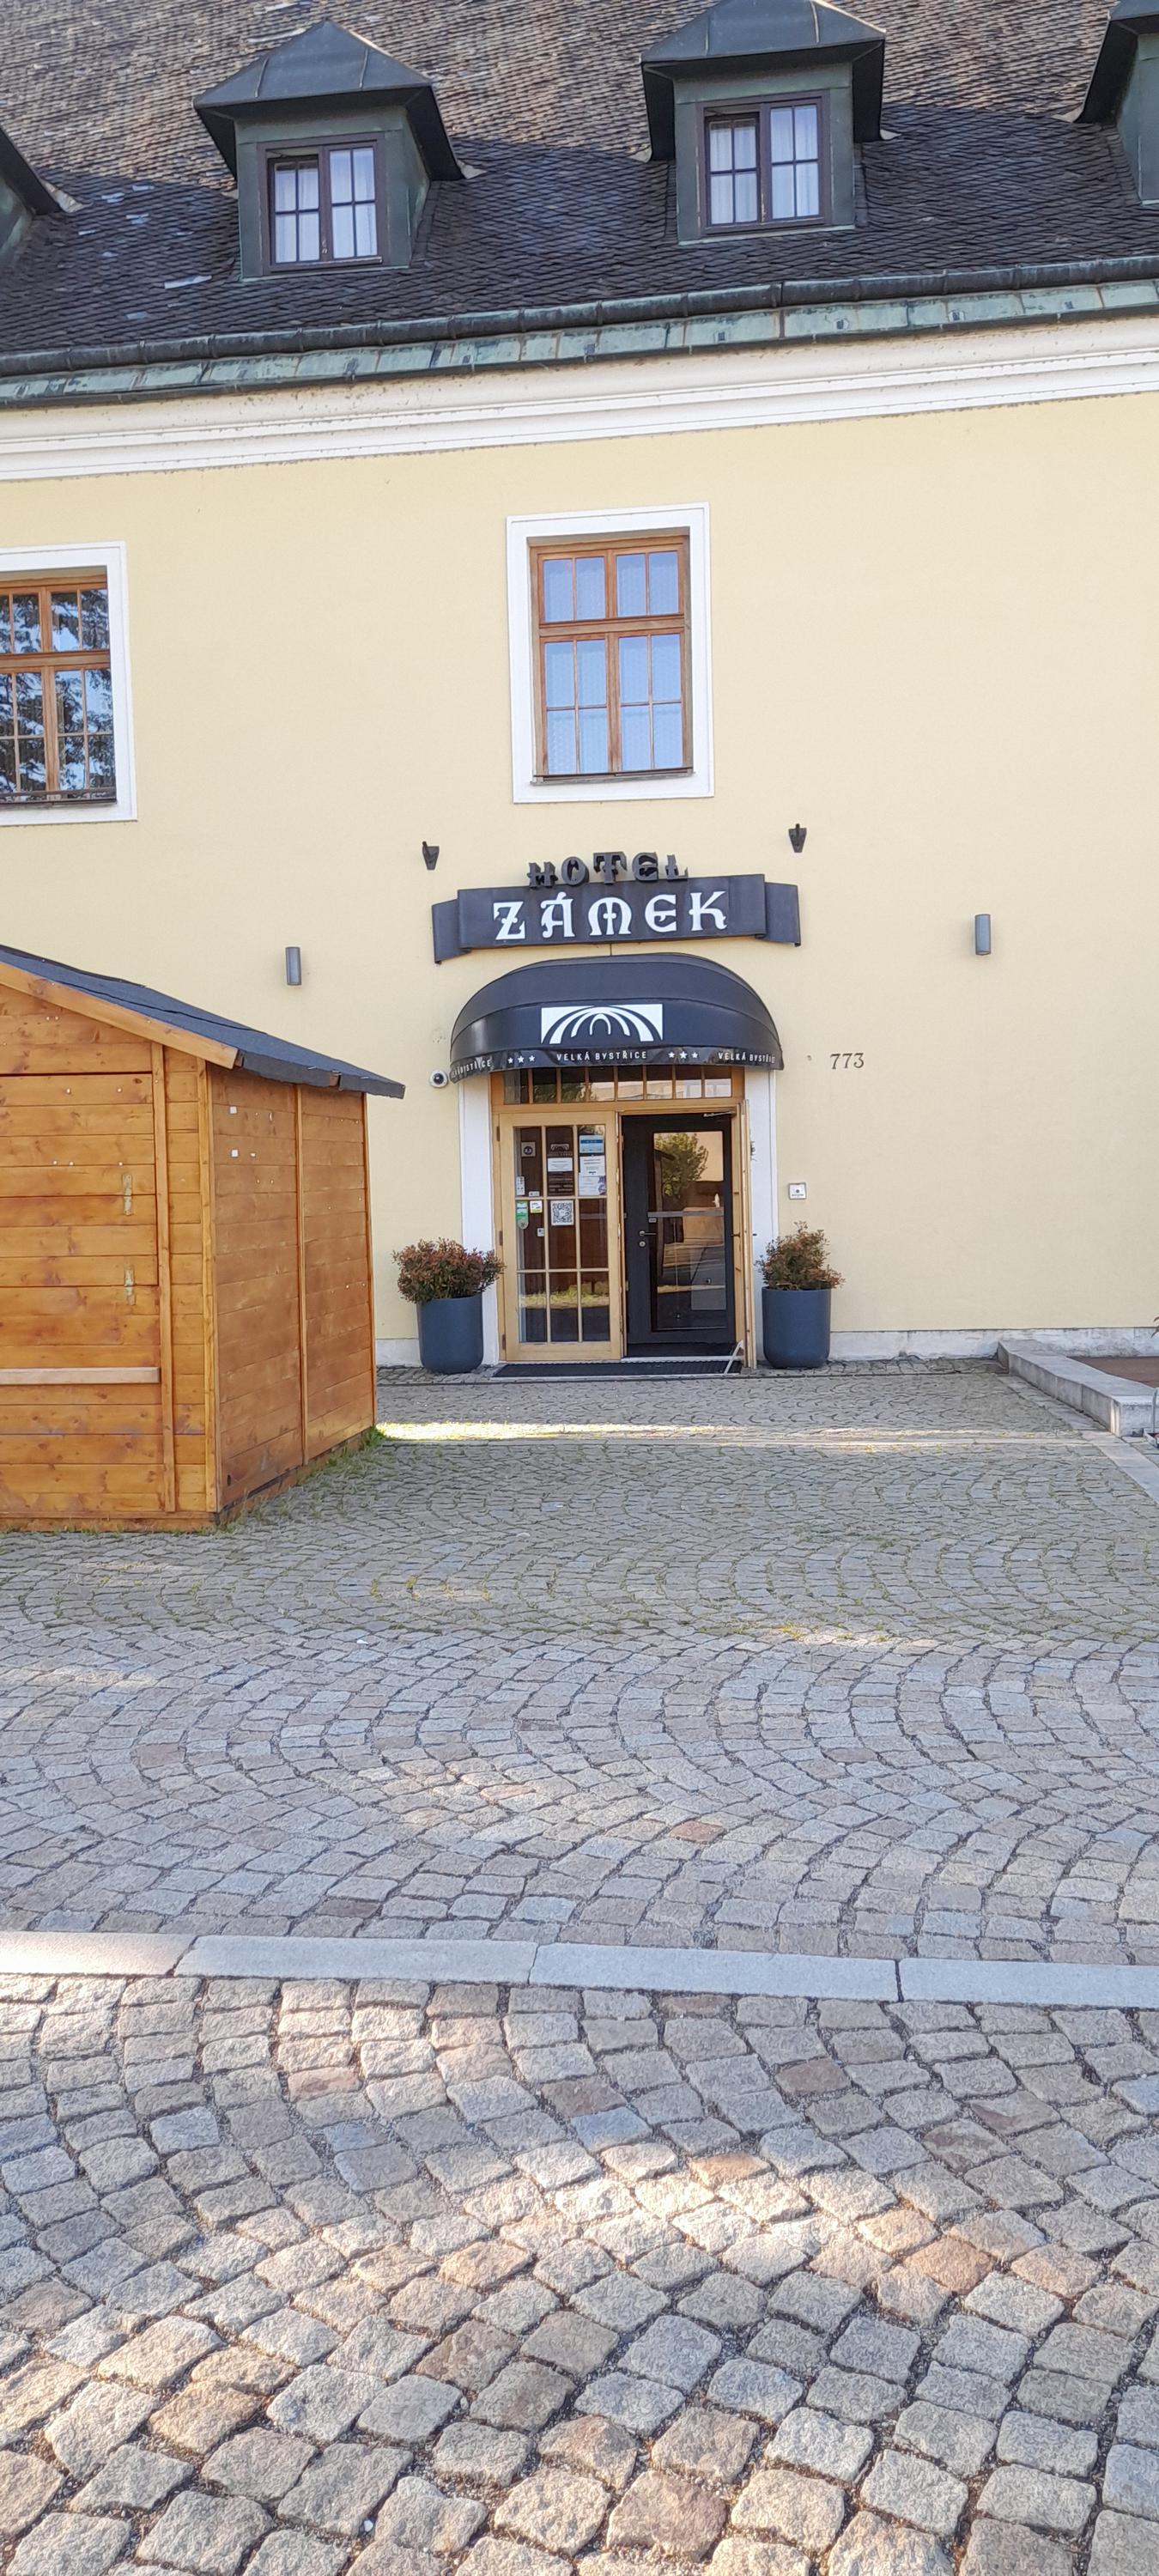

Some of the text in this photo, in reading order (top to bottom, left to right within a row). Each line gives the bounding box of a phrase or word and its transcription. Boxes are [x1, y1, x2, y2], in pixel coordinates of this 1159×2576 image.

[526, 851, 688, 888] HOTEL
[493, 891, 728, 940] ZÁMEK
[556, 1050, 646, 1061] VELKÁ BYSTŘICE
[718, 1051, 746, 1061] VELKÁ
[829, 1052, 865, 1070] 773
